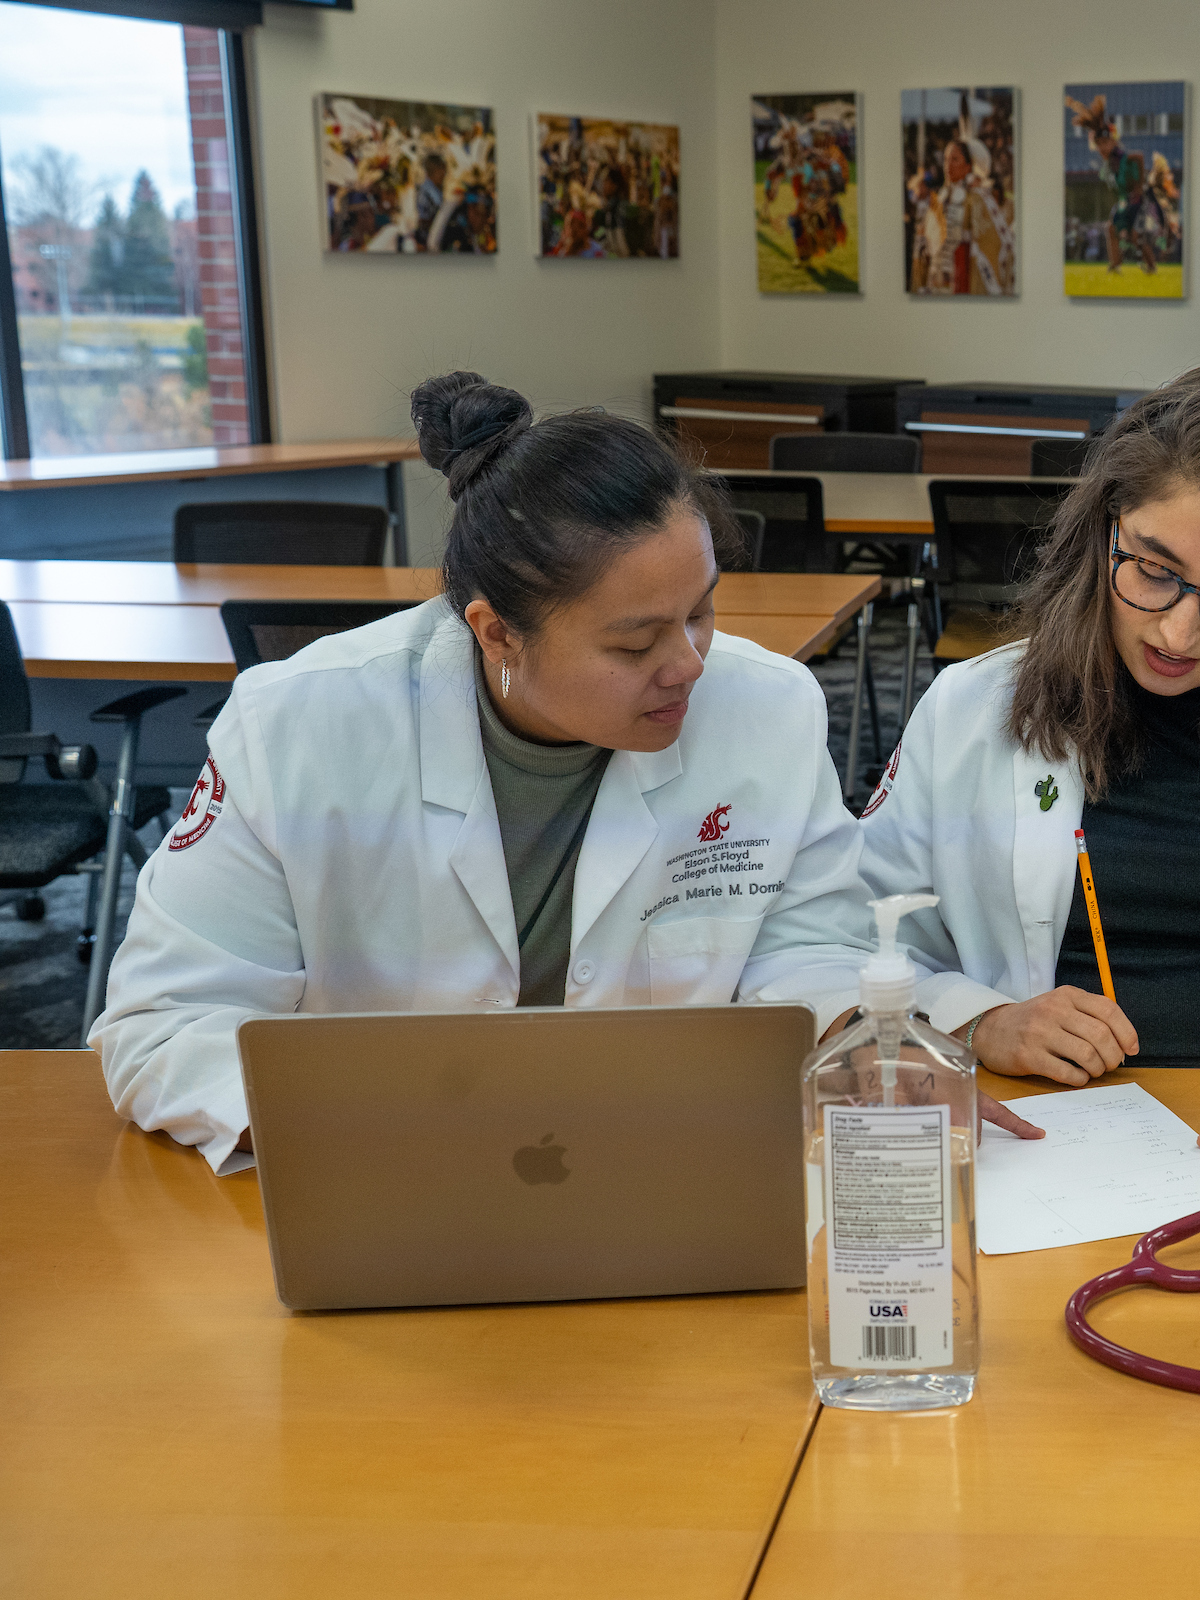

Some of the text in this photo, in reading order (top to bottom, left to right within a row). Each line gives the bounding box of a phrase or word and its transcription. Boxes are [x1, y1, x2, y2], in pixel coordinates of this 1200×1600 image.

[666, 838, 770, 866] WASHINGTON STATE UNIVERSITY
[684, 856, 710, 869] Elson
[672, 861, 764, 883] College of Medicine
[640, 880, 785, 921] Jessica Marie M. Domin
[870, 1305, 903, 1317] USA
